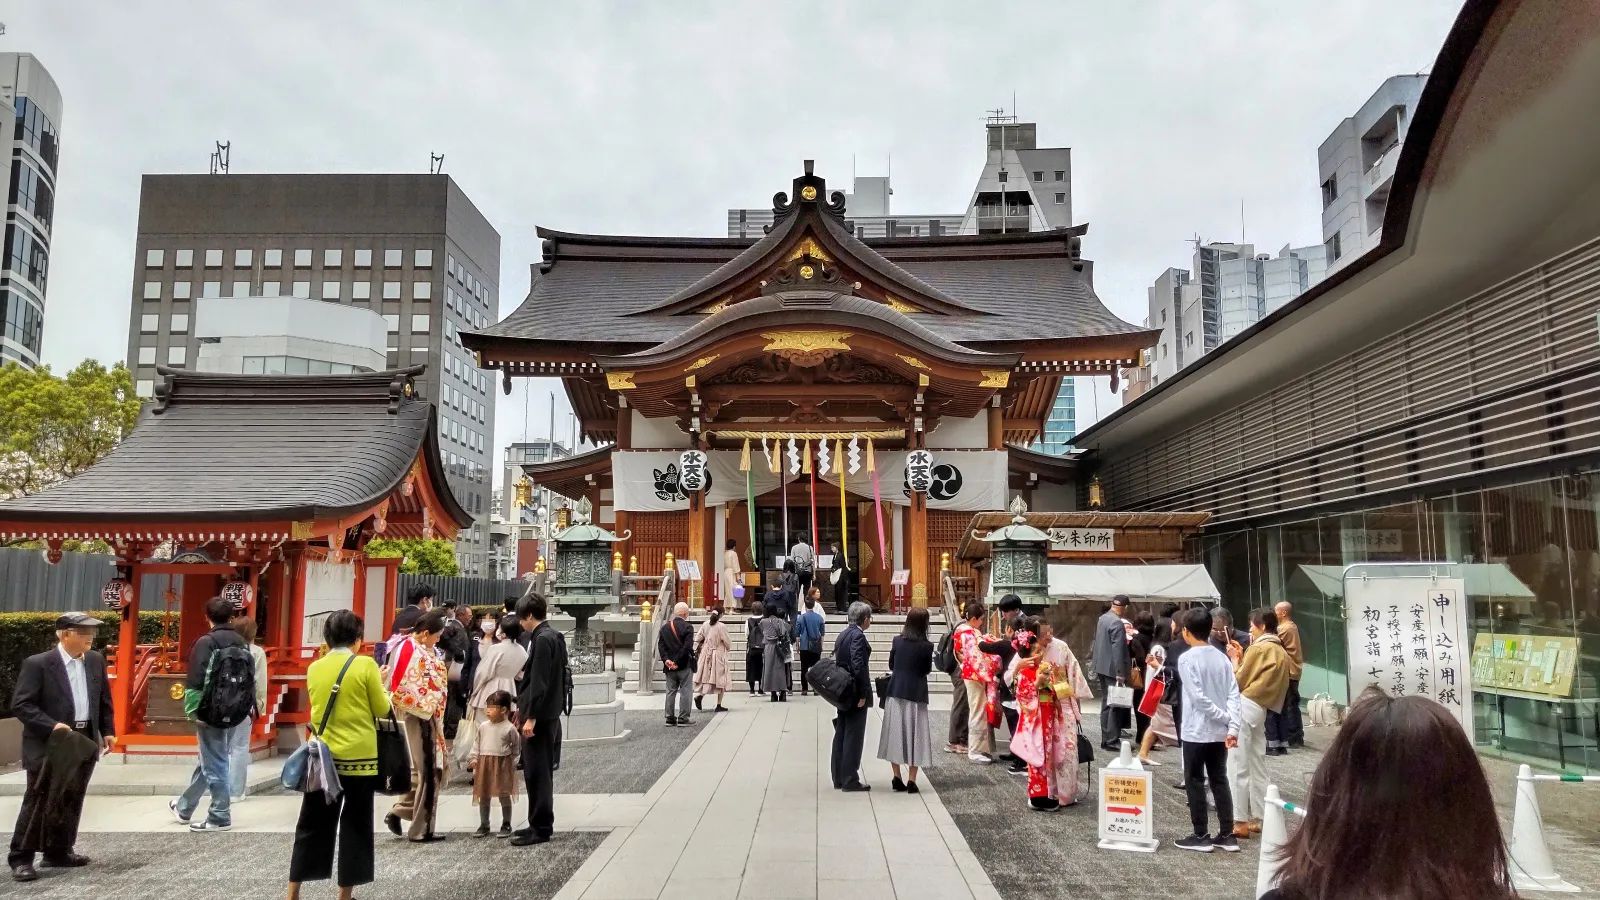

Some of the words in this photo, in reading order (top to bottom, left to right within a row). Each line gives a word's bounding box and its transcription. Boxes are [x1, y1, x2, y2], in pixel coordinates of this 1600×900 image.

[683, 452, 702, 488] 水天宮
[910, 452, 929, 490] 水天宮
[1362, 606, 1383, 686] 初宮詣・七
[1432, 593, 1460, 706] 申し込み用紙
